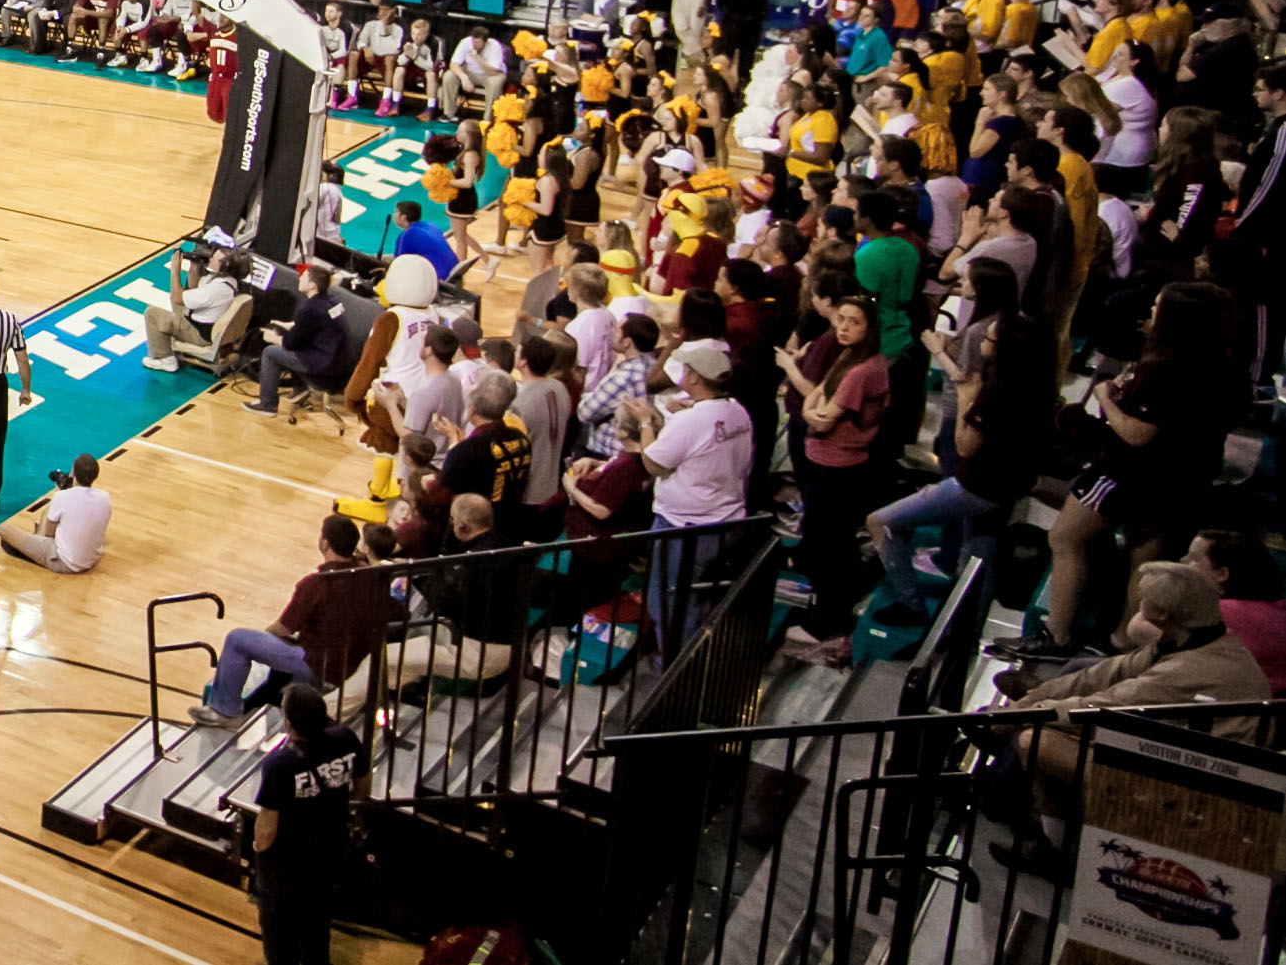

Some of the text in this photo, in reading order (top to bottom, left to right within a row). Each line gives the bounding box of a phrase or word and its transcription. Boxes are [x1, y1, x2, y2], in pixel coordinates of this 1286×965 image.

[216, 49, 226, 66] 11
[241, 48, 270, 172] BigSouthSports.com
[294, 752, 358, 791] FIRST
[1139, 741, 1241, 778] VISITOR END ZONE
[1111, 872, 1222, 917] CHAMPIONSHIPS
